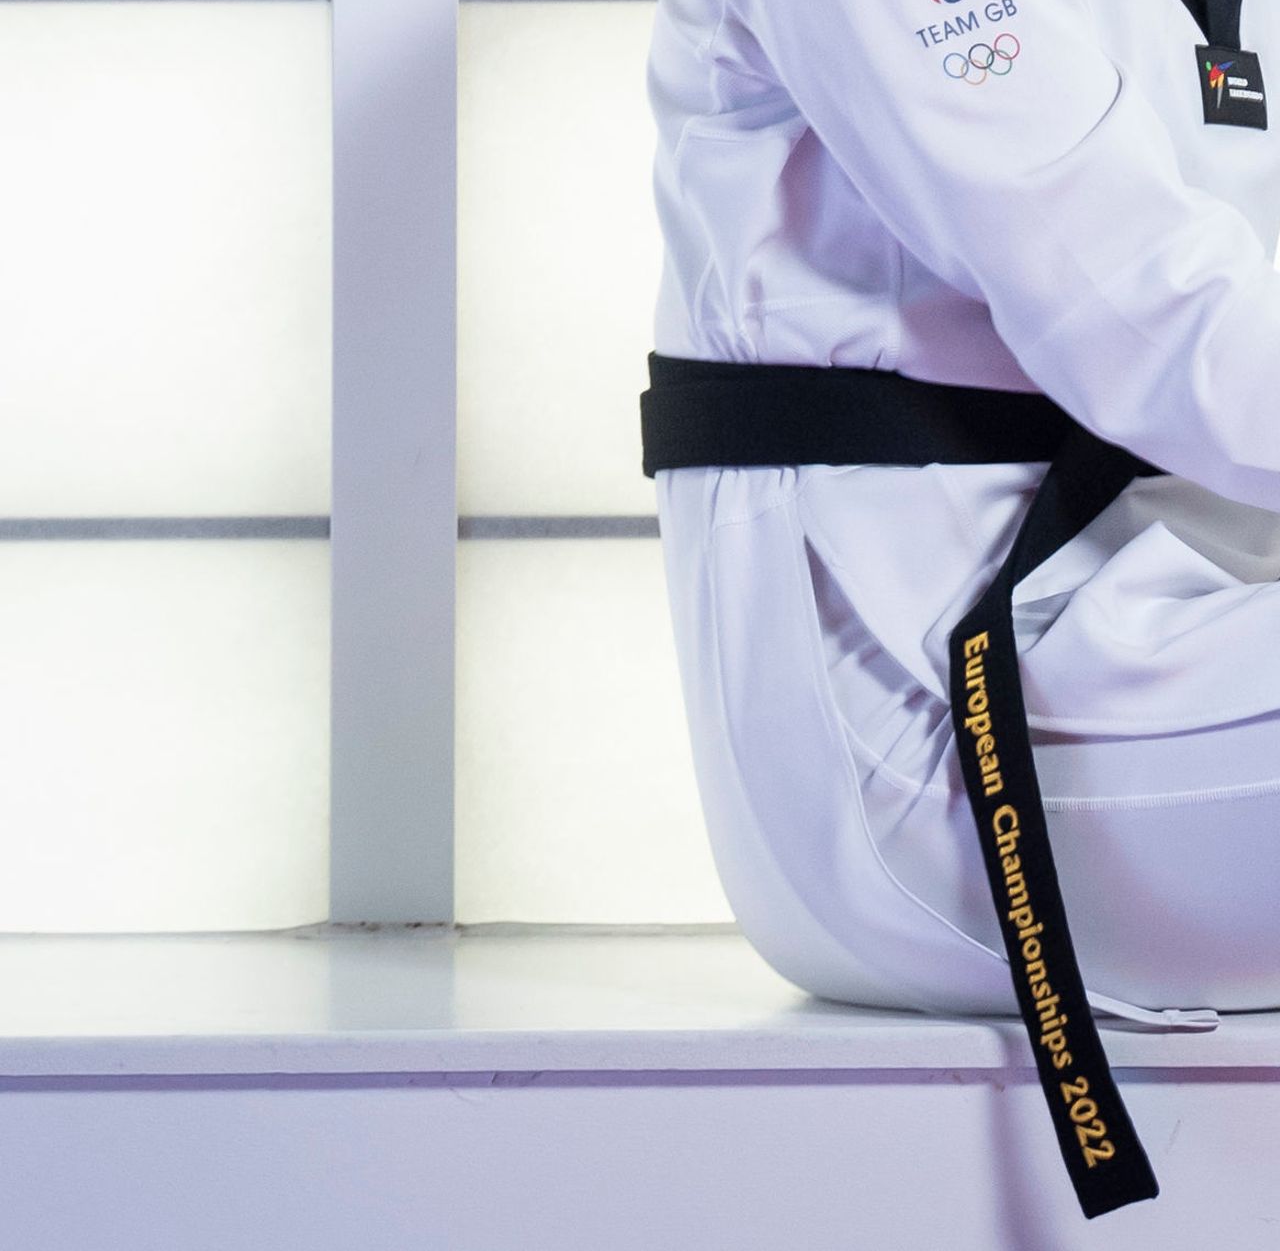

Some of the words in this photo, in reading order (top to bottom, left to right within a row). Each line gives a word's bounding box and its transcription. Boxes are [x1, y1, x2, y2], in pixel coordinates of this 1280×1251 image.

[916, 11, 980, 48] TEAM
[965, 632, 1002, 795] European
[994, 805, 1071, 1068] Championships
[1062, 1077, 1114, 1166] 2022
